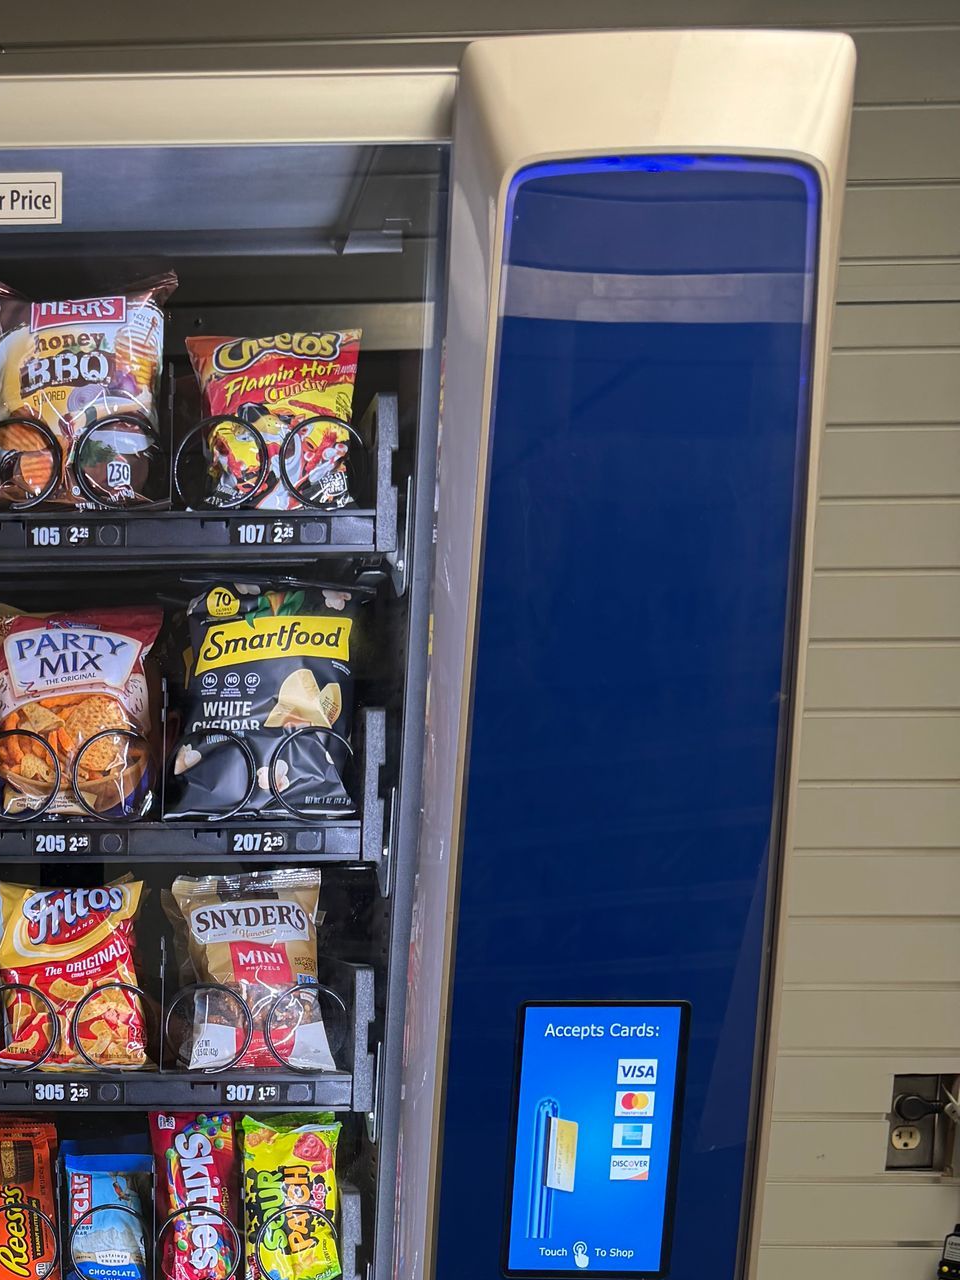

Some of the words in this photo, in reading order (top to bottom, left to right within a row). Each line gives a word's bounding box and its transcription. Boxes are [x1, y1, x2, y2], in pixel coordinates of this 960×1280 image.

[11, 190, 51, 210] Price
[34, 333, 105, 354] honey
[25, 352, 110, 392] BBQ
[300, 363, 335, 378] Hot
[264, 379, 328, 404] Crunchy
[108, 463, 129, 483] 230
[31, 527, 60, 546] 105
[238, 525, 264, 543] 107
[214, 592, 232, 607] 70
[16, 633, 128, 660] PARTY
[203, 622, 342, 661] Smartfood
[39, 651, 103, 679] MIX
[61, 673, 96, 683] ORIGINAL
[203, 701, 252, 717] WHITE
[36, 835, 65, 852] 205
[233, 834, 261, 851] 207
[23, 887, 122, 944] Fritos
[195, 905, 306, 933] SNYDER'S
[65, 920, 94, 938] BRAND
[45, 966, 62, 977] The
[66, 941, 127, 972] ORIGINAL
[238, 951, 284, 966] MINI
[545, 1024, 605, 1040] Accepts
[610, 1023, 660, 1037] Cards:
[620, 1065, 655, 1078] VISA
[35, 1083, 64, 1100] 305
[226, 1084, 253, 1101] 307
[612, 1160, 648, 1168] DISCOVER
[74, 1174, 89, 1213] CLIF
[175, 1133, 223, 1269] Skittles
[258, 1171, 287, 1250] SOUR
[284, 1165, 313, 1254] PATCH
[539, 1247, 568, 1257] Touch
[595, 1248, 607, 1257] To
[610, 1248, 634, 1258] Shop
[89, 1269, 136, 1277] CHOCOLATE
